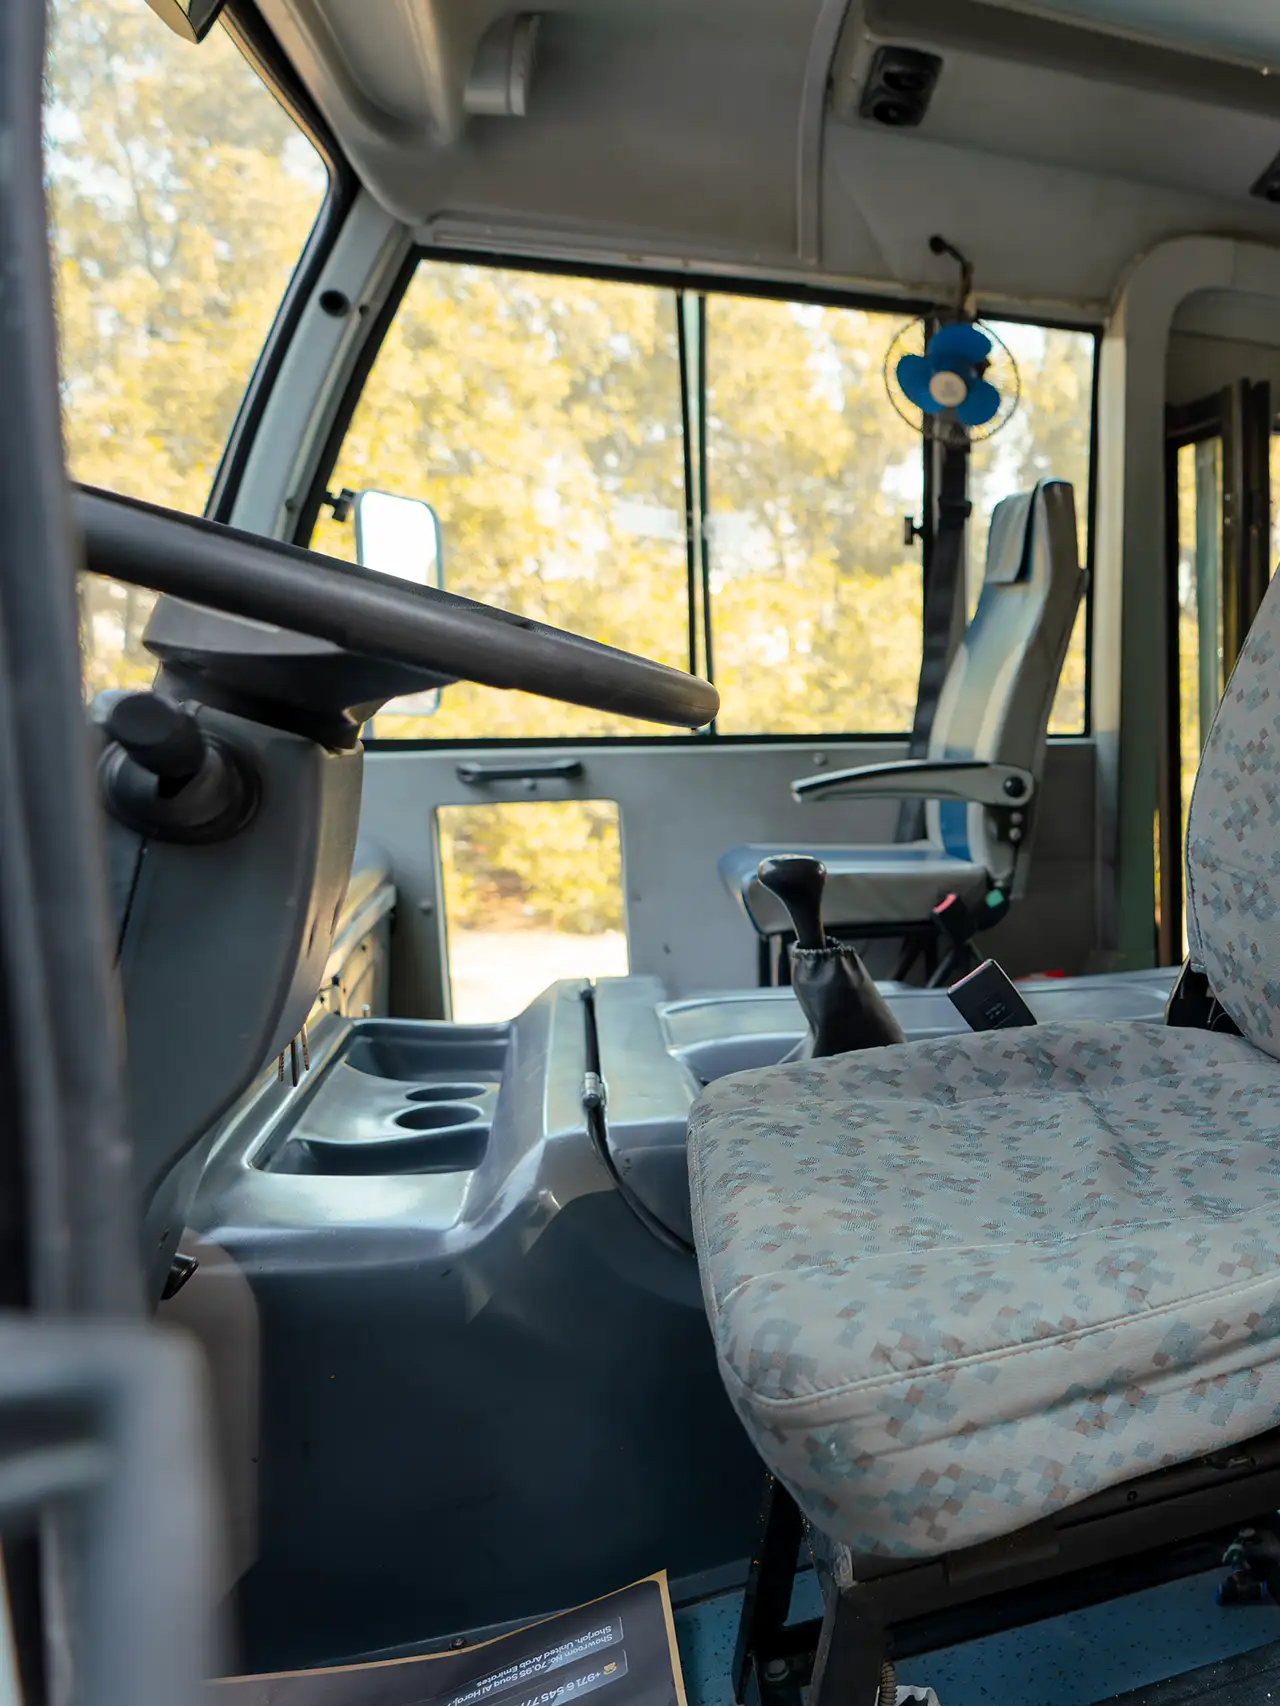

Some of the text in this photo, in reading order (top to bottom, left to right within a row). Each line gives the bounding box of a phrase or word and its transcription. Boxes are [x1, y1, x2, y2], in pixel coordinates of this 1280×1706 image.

[544, 1640, 574, 1659] United
[564, 1633, 613, 1657] Showroom
[519, 1655, 544, 1670] Arab
[476, 1664, 518, 1688] Emirates
[493, 1673, 519, 1688] Souq
[576, 1671, 602, 1687] +971
[566, 1681, 575, 1691] 6
[540, 1686, 565, 1703] 545
